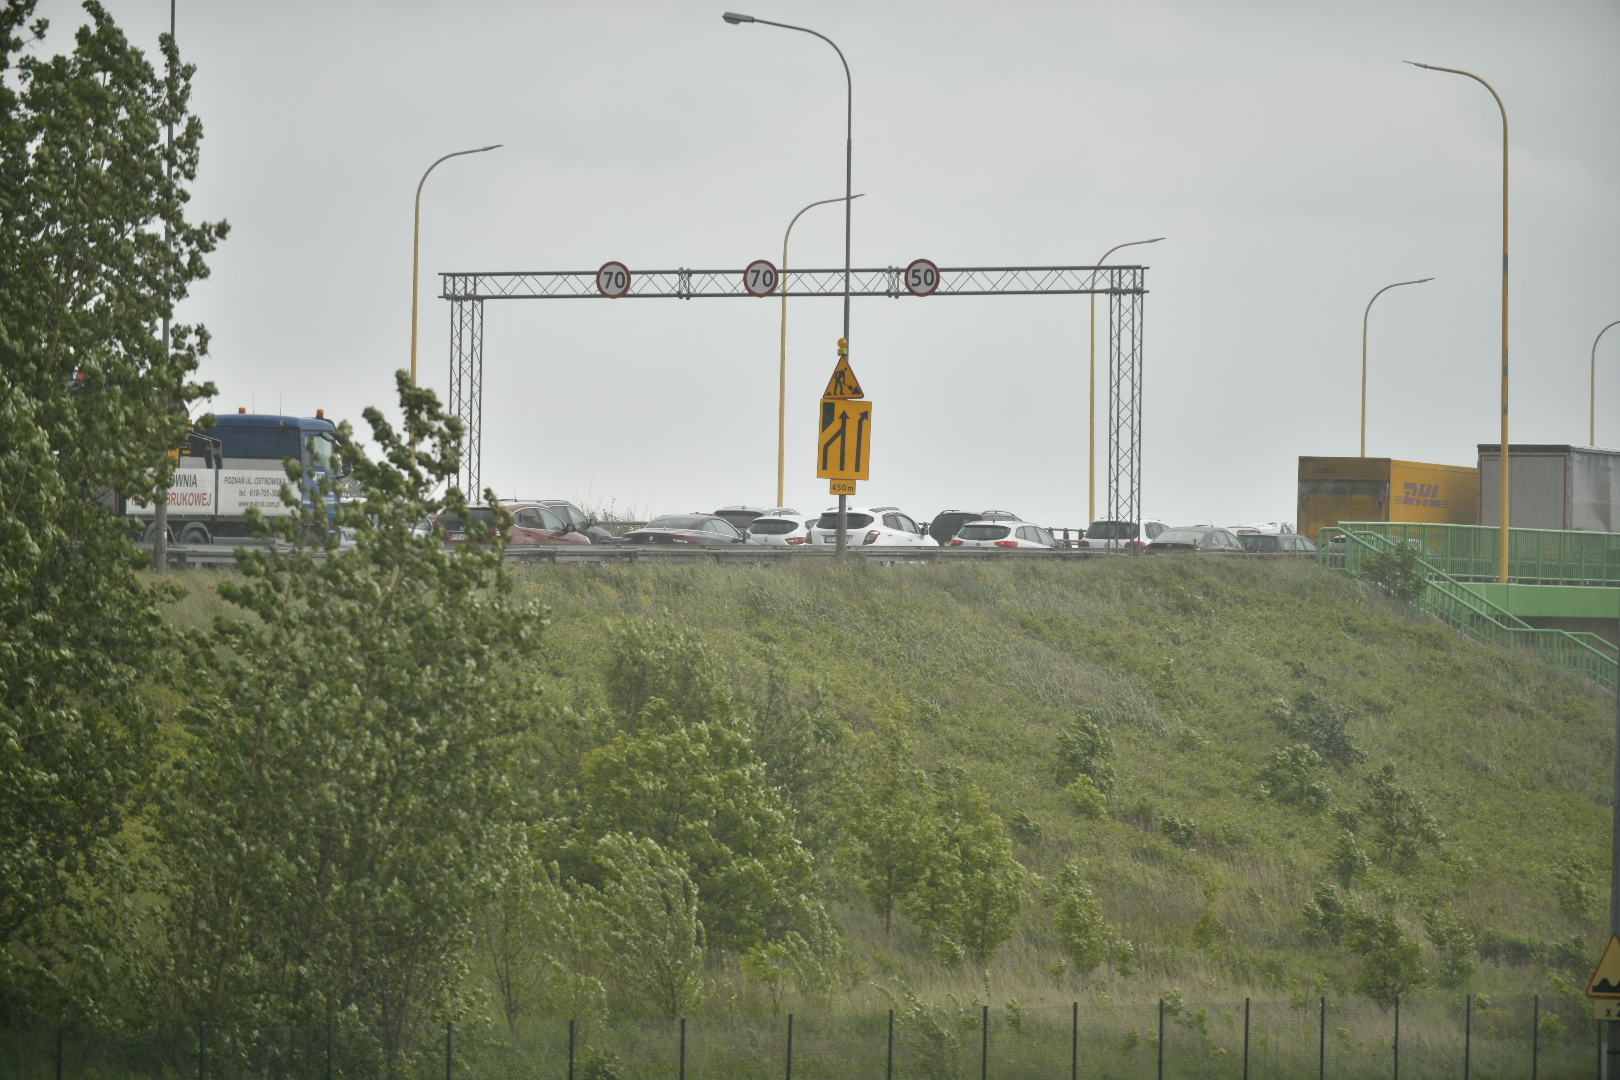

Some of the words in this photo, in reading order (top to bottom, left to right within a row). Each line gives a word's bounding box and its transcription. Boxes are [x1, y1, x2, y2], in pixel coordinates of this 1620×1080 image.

[604, 272, 626, 289] 70
[751, 270, 774, 288] 70
[912, 268, 934, 286] 50
[224, 476, 245, 485] POZNAŃ
[255, 478, 286, 486] OSTROWSKA
[167, 492, 212, 506] BRUKOWEJ
[238, 489, 247, 497] tel.
[1402, 482, 1440, 508] DHL
